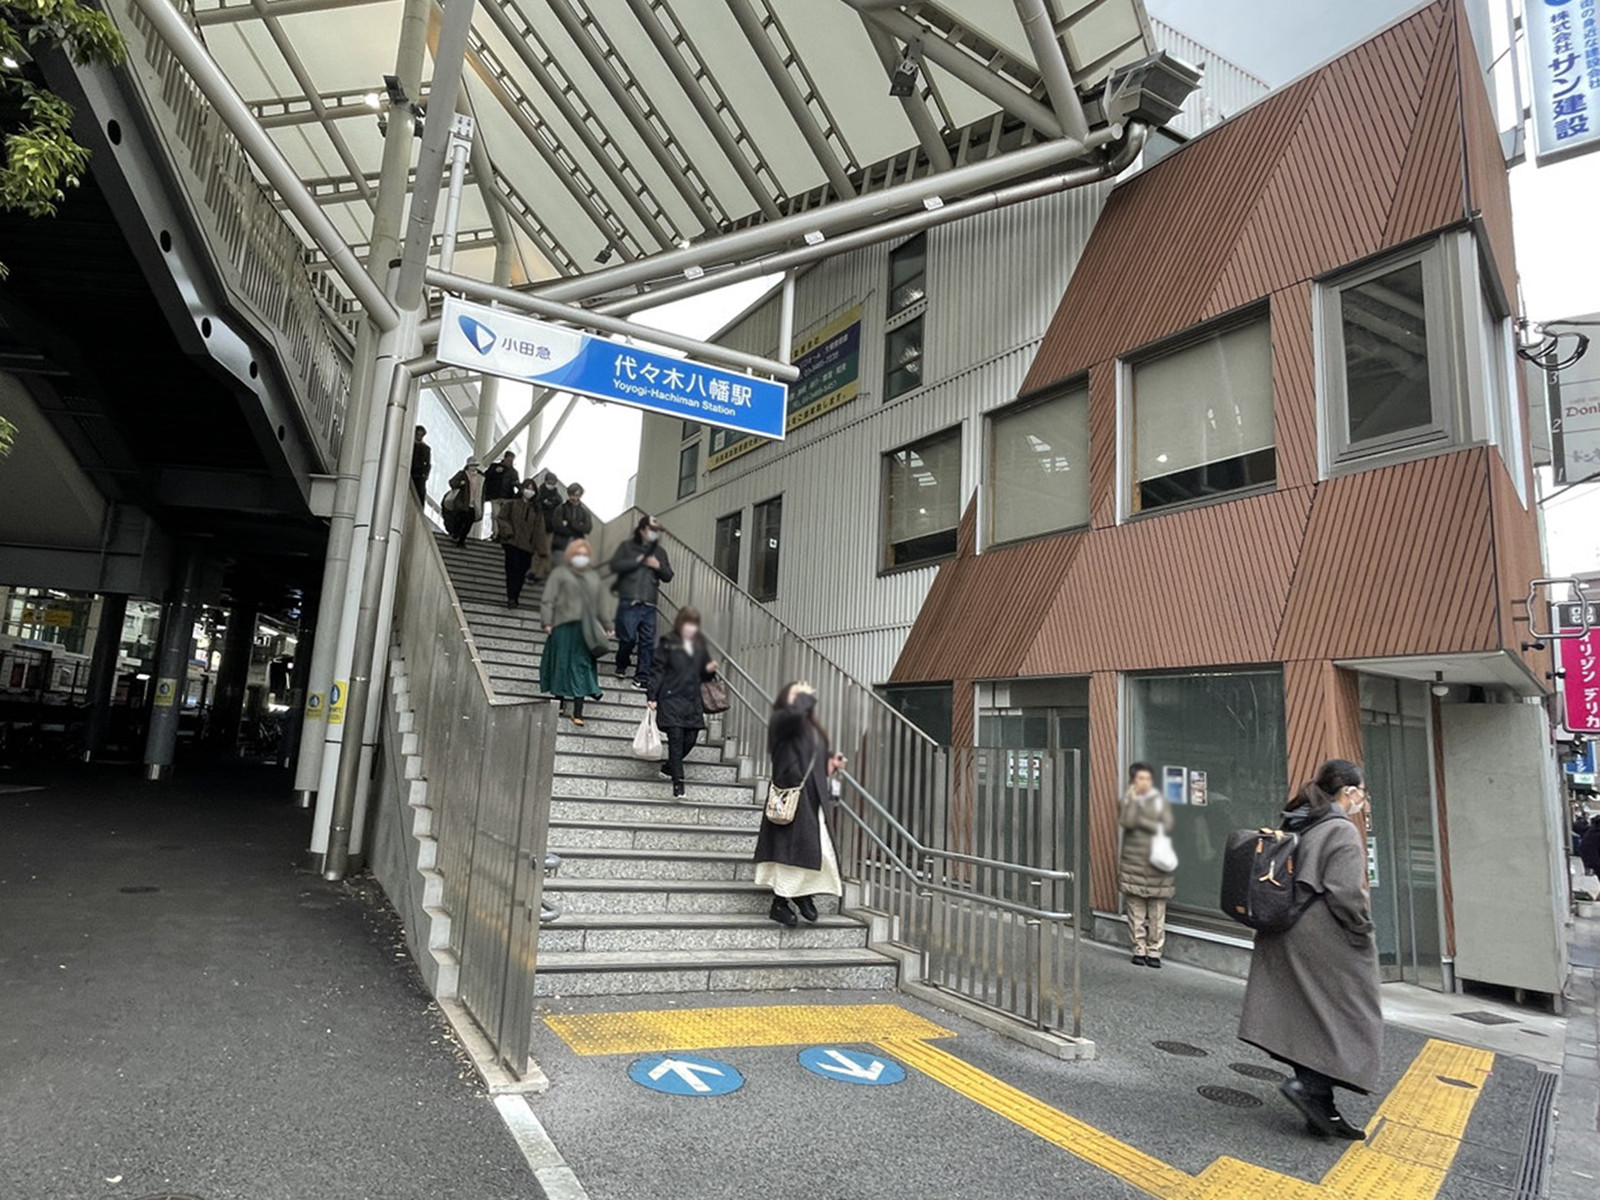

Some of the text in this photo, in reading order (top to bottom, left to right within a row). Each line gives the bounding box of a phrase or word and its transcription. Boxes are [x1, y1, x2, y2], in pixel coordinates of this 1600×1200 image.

[1548, 11, 1589, 140] 株式会社サン建設
[501, 337, 551, 360] 小田急
[614, 353, 752, 408] 代々木八幡駅
[1549, 371, 1559, 386] 3
[613, 378, 736, 417] Yoyogi-Hachiman Station
[1551, 418, 1562, 433] 2
[1557, 467, 1564, 482] 1
[1584, 687, 1600, 728] デリカ
